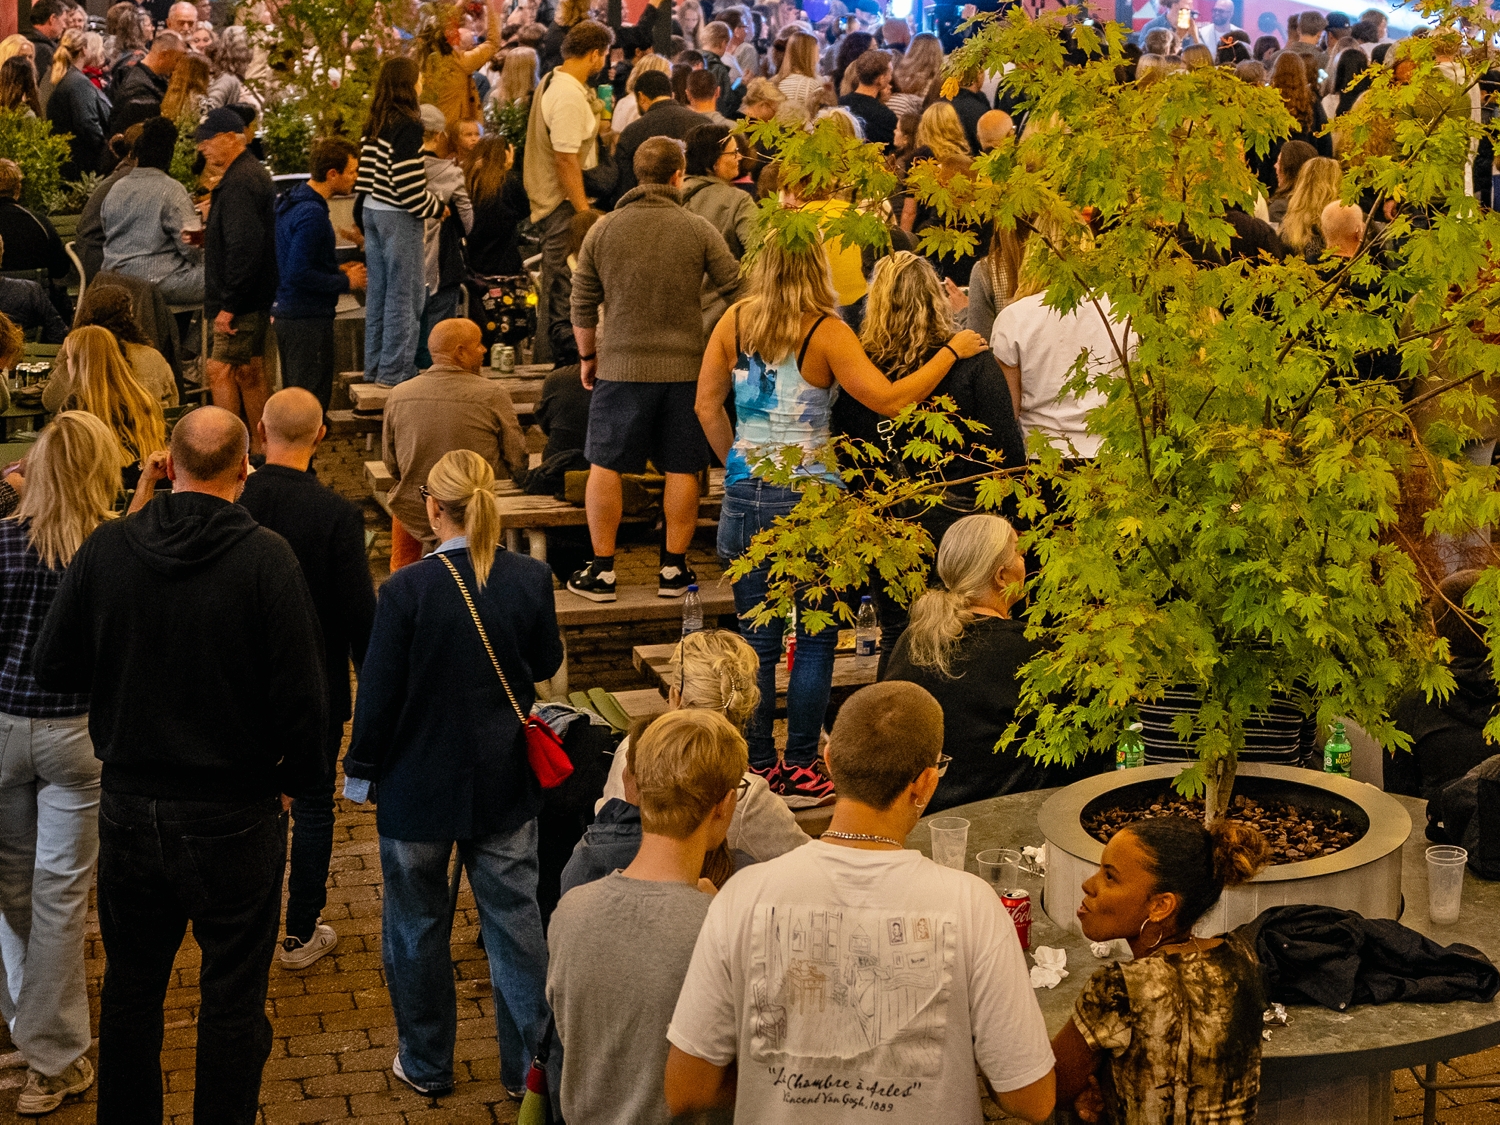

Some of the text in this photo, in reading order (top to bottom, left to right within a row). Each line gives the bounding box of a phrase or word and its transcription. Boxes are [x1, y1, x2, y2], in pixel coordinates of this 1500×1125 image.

[783, 1089, 822, 1104] Vincent
[822, 1092, 840, 1104] Van
[870, 1101, 894, 1112] 1889
